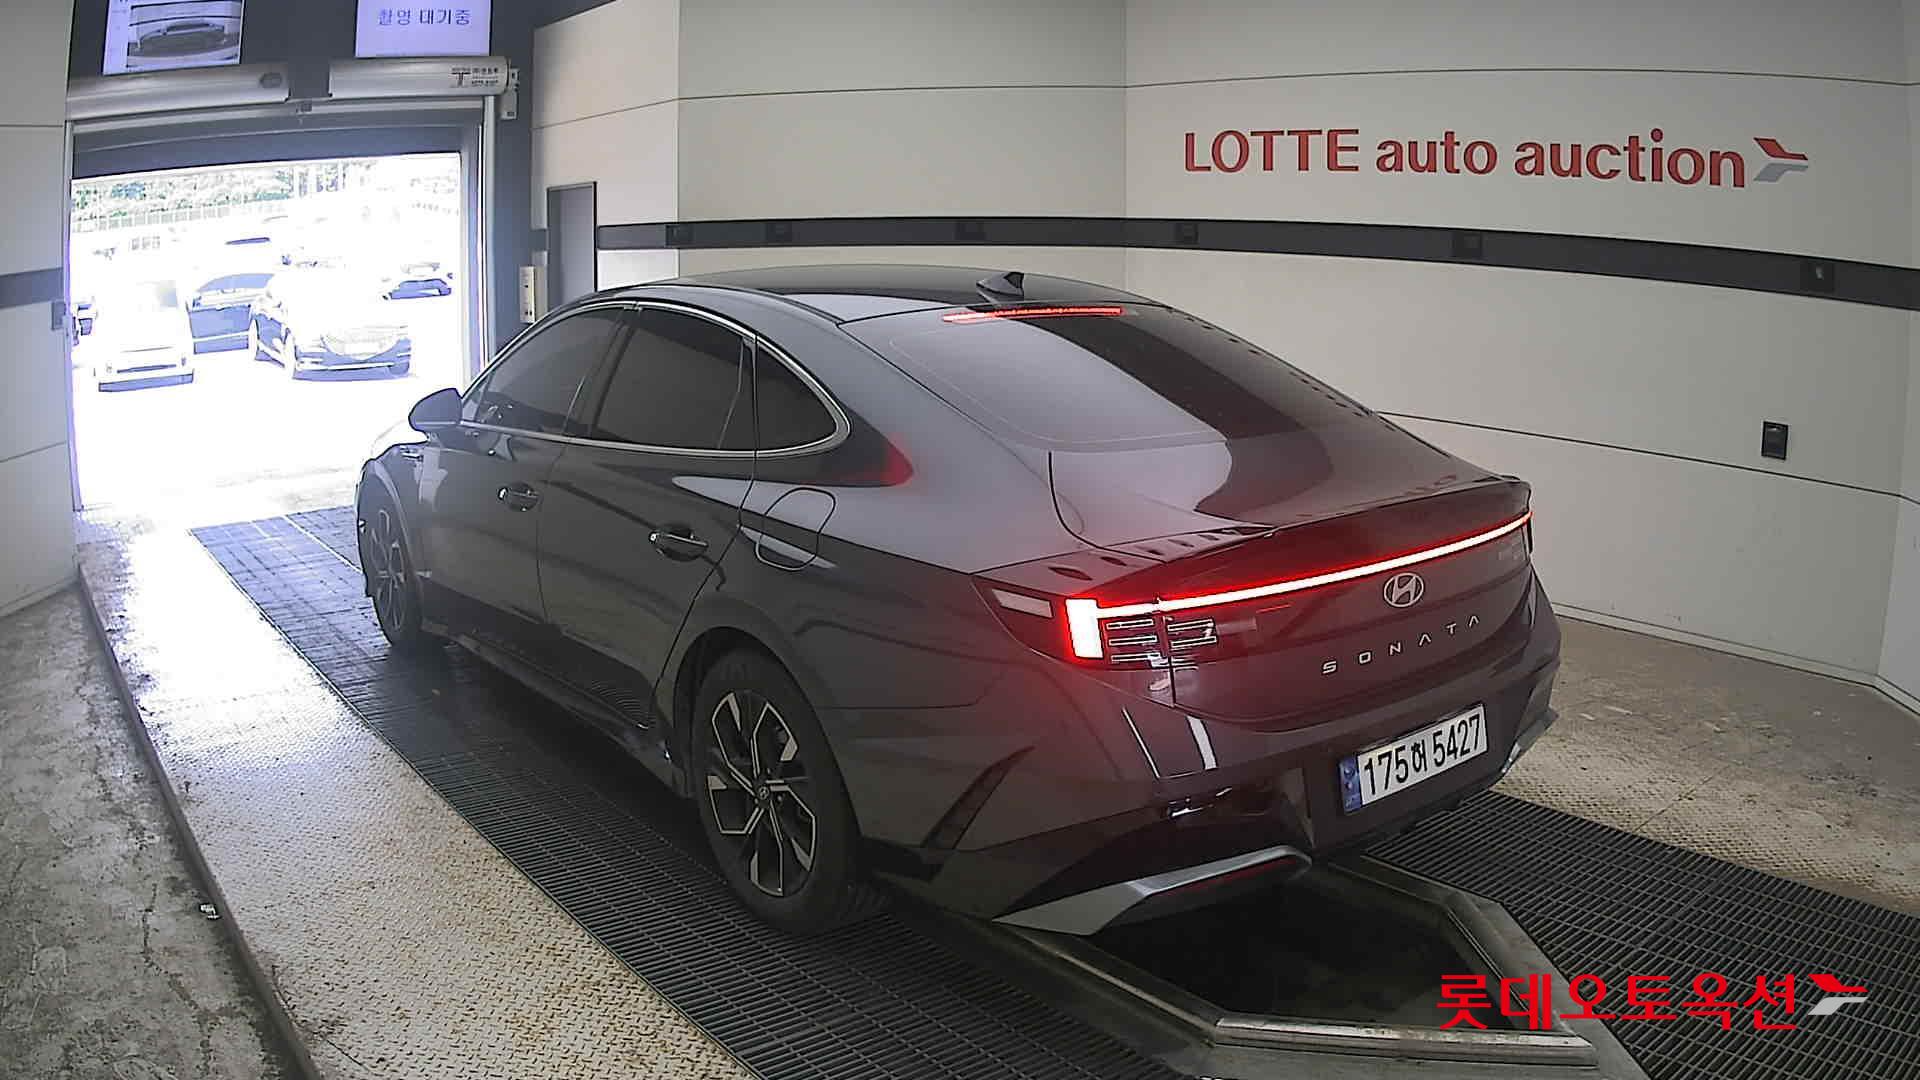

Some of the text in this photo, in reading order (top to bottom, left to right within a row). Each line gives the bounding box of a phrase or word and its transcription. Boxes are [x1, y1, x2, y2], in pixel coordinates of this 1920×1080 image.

[419, 8, 471, 26] 대기중
[1184, 128, 1746, 188] LOTTE auto auction
[1322, 615, 1480, 674] SONATA
[1432, 713, 1481, 768] 5427
